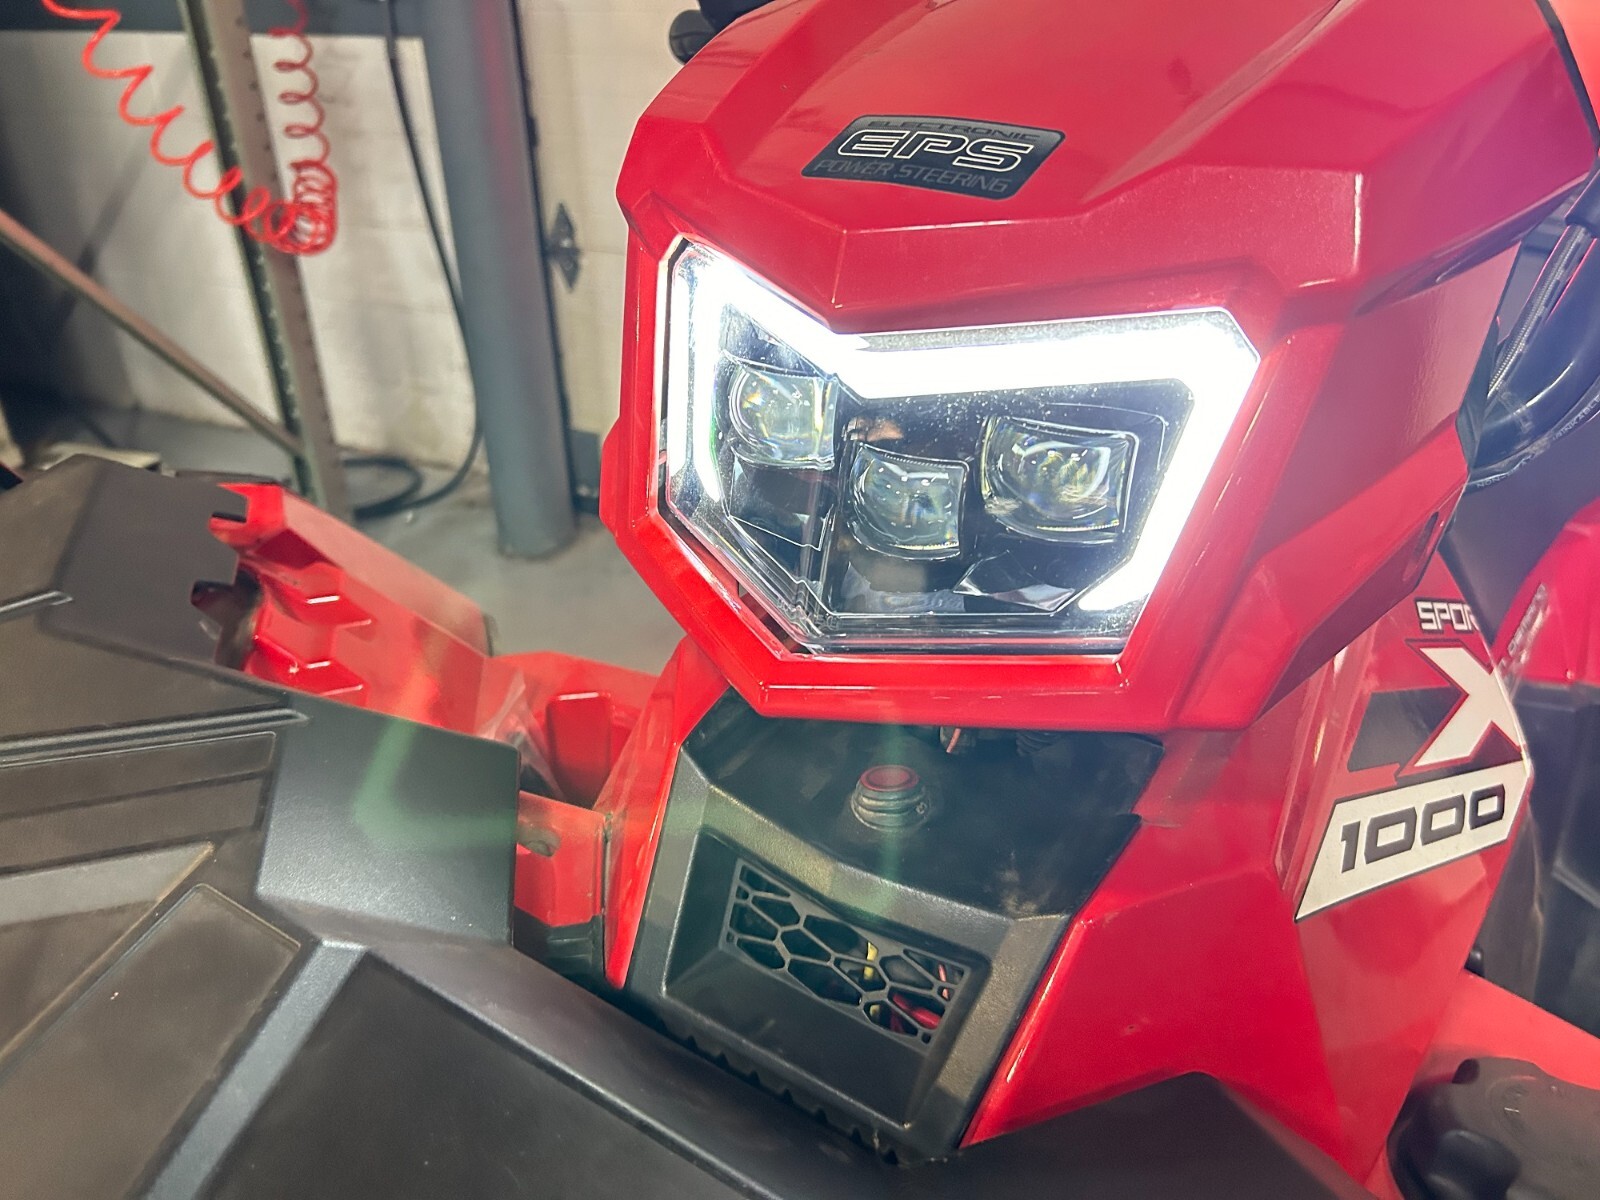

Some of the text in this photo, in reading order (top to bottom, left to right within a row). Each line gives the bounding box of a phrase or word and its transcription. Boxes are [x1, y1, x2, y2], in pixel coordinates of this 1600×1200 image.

[867, 120, 1041, 142] ELECTRONIC
[838, 129, 1035, 173] EPS
[813, 159, 1012, 193] POWER STEERING
[1340, 783, 1506, 874] 1000
